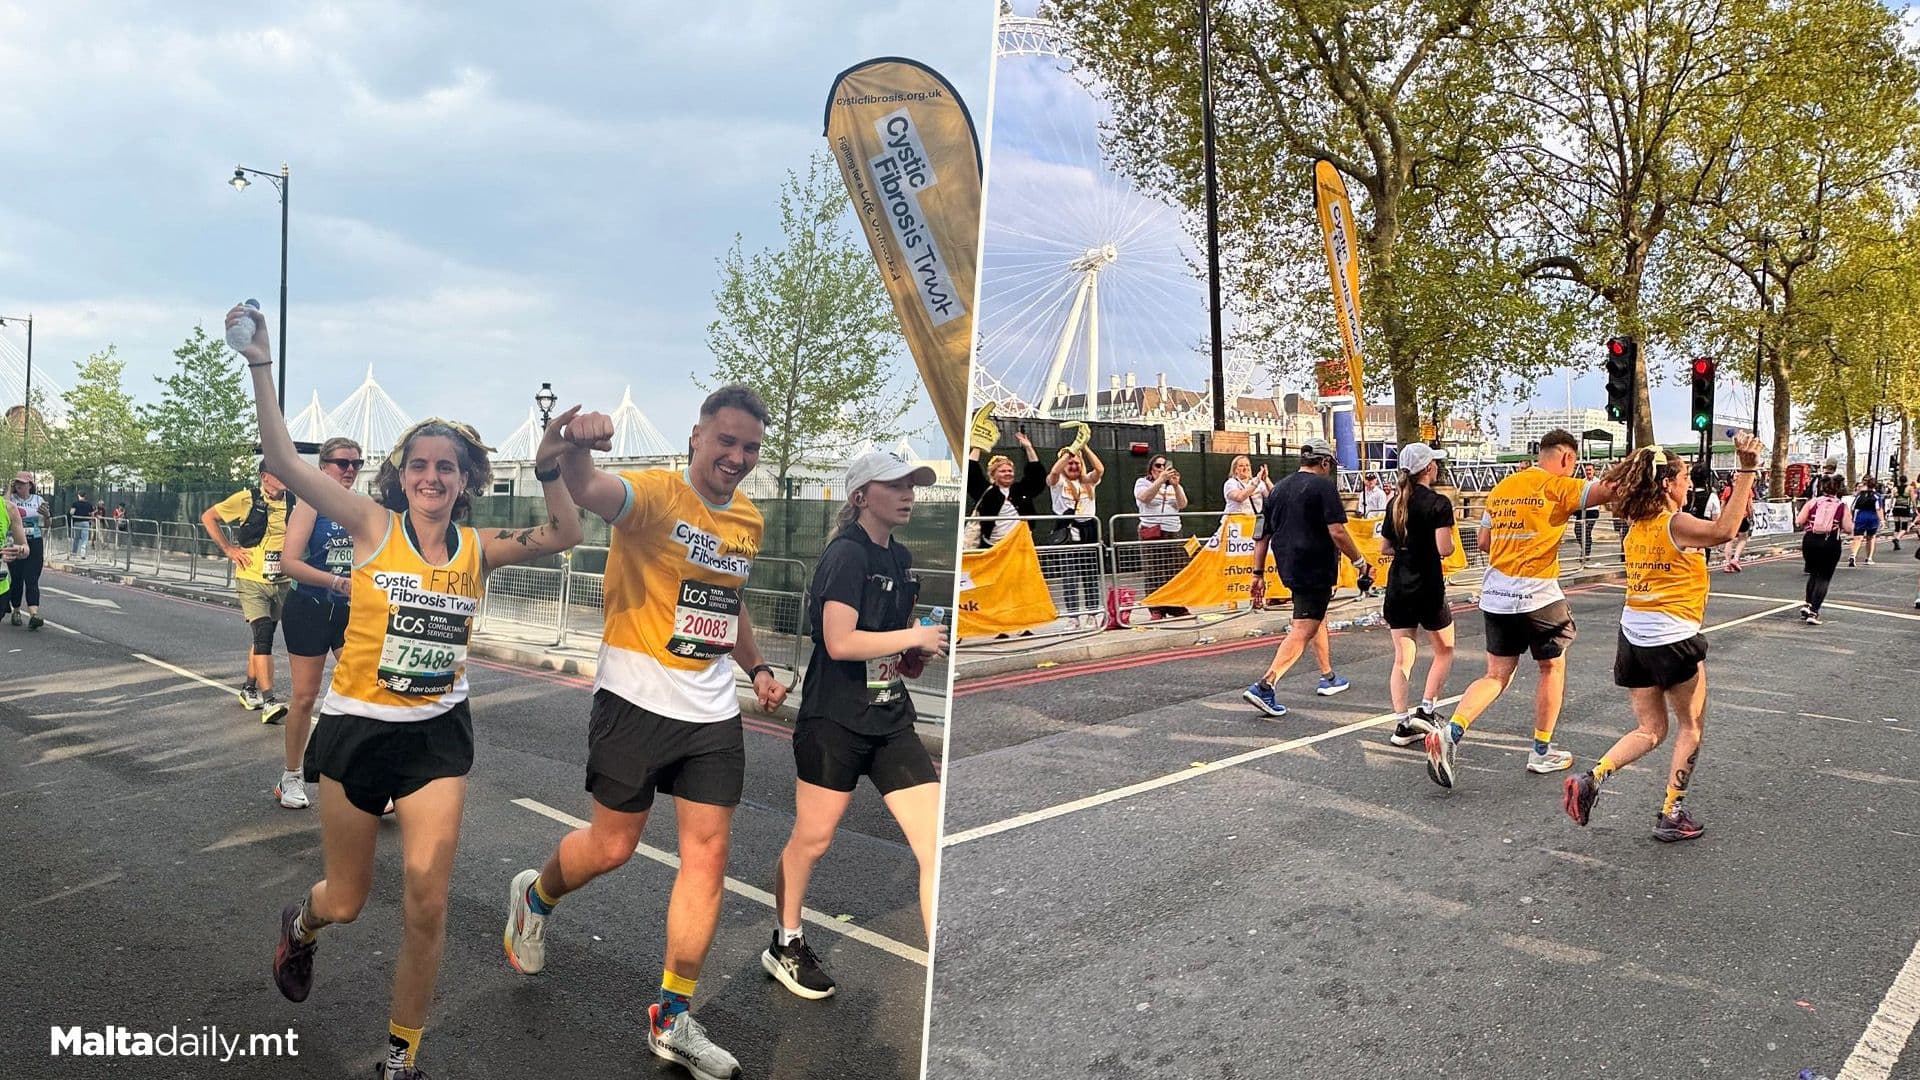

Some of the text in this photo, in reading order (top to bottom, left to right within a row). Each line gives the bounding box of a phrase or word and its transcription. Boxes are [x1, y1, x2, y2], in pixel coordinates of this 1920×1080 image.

[836, 89, 942, 105] cysticfibrosis.org.uk
[838, 136, 856, 170] Fighting
[851, 168, 862, 181] for
[887, 116, 926, 188] Cystic
[874, 156, 953, 316] Fibrosis Trust
[676, 523, 717, 551] Cystic
[690, 546, 737, 573] Fibrosis
[1635, 561, 1671, 572] running
[374, 574, 418, 589] Cystic
[430, 569, 477, 598] FRAN
[710, 588, 724, 596] TATA
[390, 588, 446, 608] Fibrosis
[429, 615, 448, 624] TATA
[682, 614, 728, 639] 20083
[426, 629, 454, 639] SERVICES
[397, 645, 455, 670] 75488
[656, 1040, 701, 1067] BROOKS
